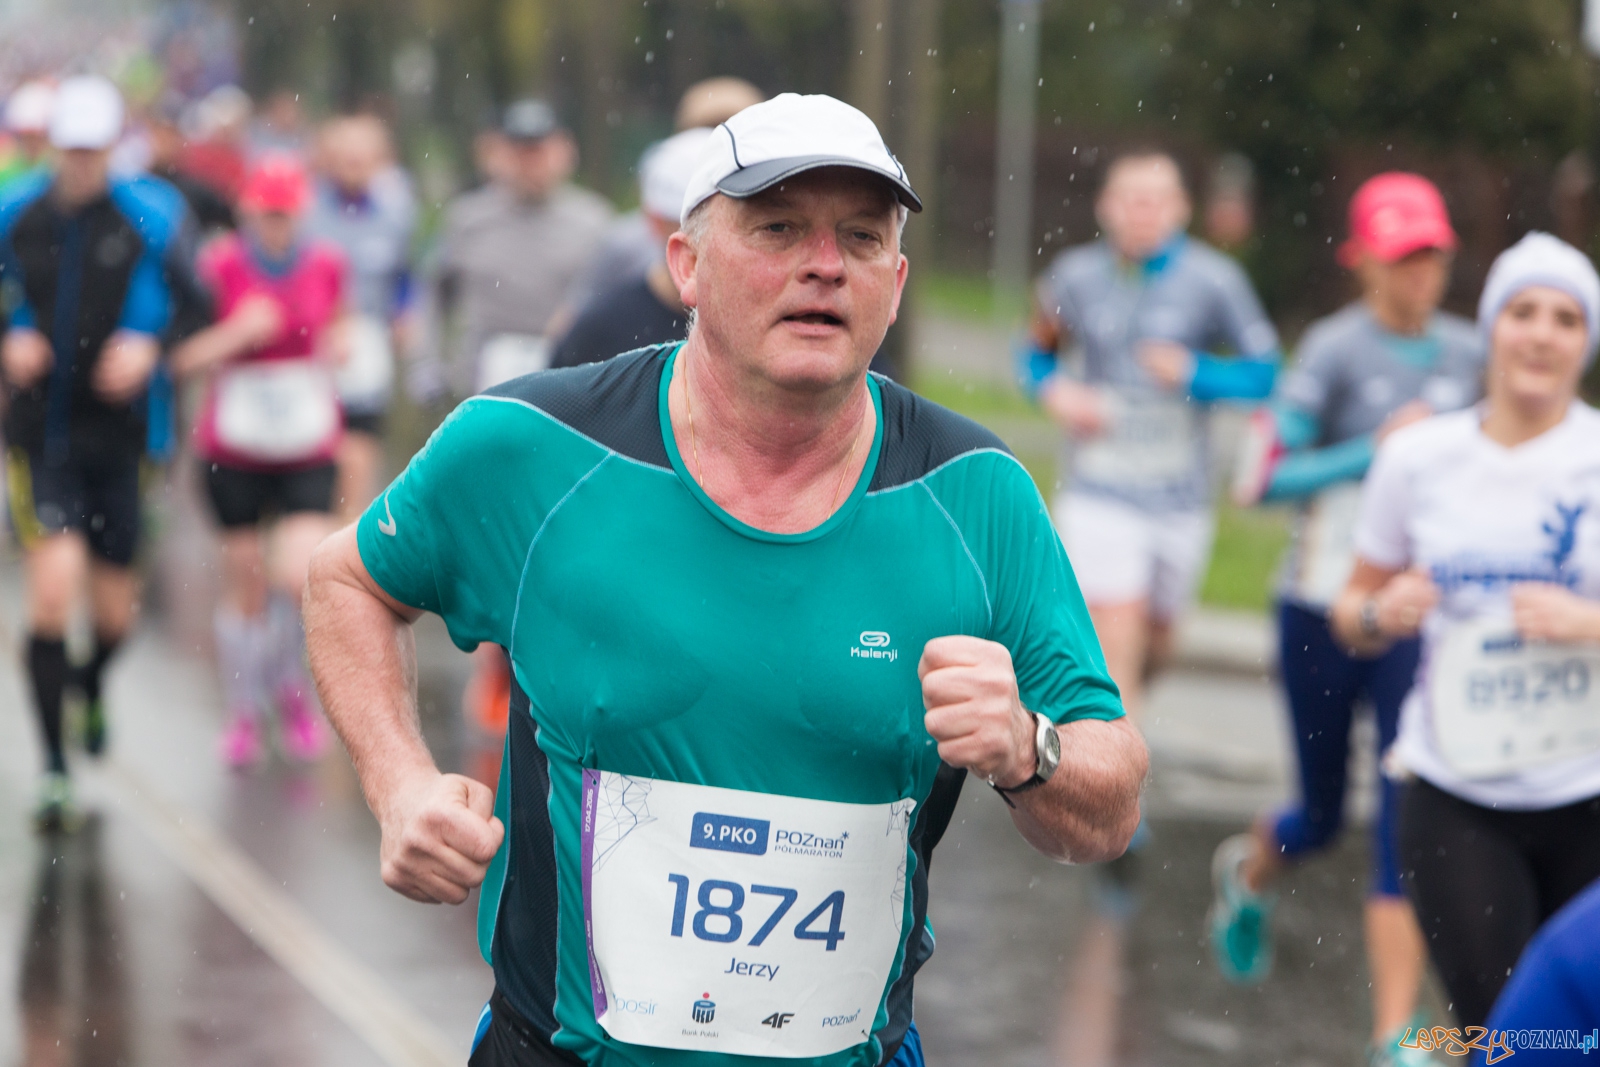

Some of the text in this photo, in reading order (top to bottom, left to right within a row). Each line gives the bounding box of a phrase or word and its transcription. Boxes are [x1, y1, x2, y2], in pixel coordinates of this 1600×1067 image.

[850, 646, 898, 662] Kalenji
[719, 825, 757, 845] PKO
[668, 873, 846, 952] 1874
[724, 958, 780, 981] Jerzy
[761, 1012, 795, 1029] 4F
